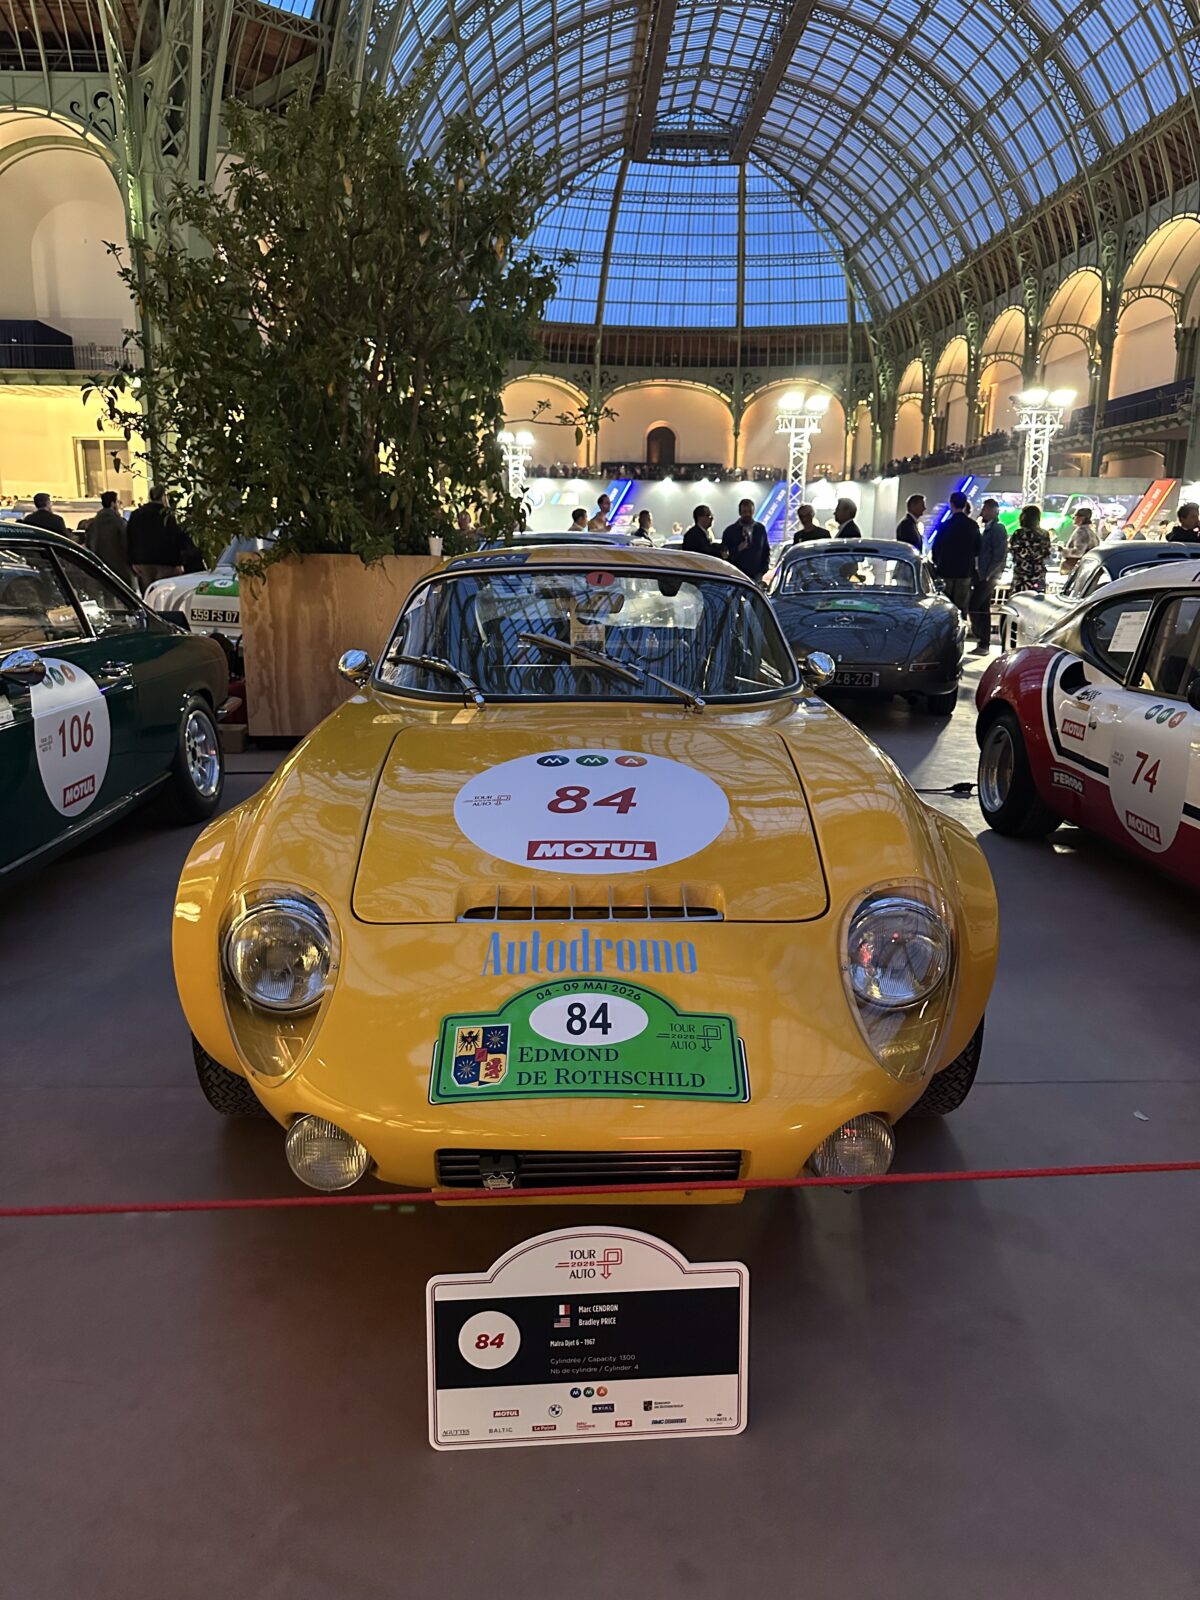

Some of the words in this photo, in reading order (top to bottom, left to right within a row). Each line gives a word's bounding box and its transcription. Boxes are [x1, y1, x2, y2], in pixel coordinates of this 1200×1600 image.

[452, 555, 523, 566] AXIAL
[192, 609, 209, 620] 359
[211, 610, 224, 622] FS
[225, 611, 238, 623] 07
[59, 711, 94, 757] 106
[1062, 721, 1085, 738] MOTUL
[1131, 751, 1161, 793] 74
[65, 777, 95, 804] MOTUL
[547, 785, 637, 814] 84
[1127, 814, 1160, 842] MOTUL
[532, 842, 651, 858] MOTUL
[481, 928, 698, 976] Autodromo
[536, 988, 552, 1001] 04
[563, 981, 579, 992] 09
[583, 981, 608, 991] MAI
[612, 983, 641, 1001] 2026
[566, 1002, 612, 1035] 84
[670, 1023, 695, 1033] TOUR
[670, 1040, 697, 1050] AUTO
[518, 1046, 619, 1063] EDMOND
[516, 1071, 547, 1086] DE
[554, 1068, 705, 1088] ROTHSCHILD
[569, 1250, 596, 1259] TOUR
[569, 1268, 596, 1279] AUTO
[578, 1305, 591, 1313] Marc
[592, 1304, 618, 1312] CENDRON
[578, 1318, 599, 1326] Bradley
[600, 1317, 616, 1325] PRICE
[475, 1333, 505, 1350] 84
